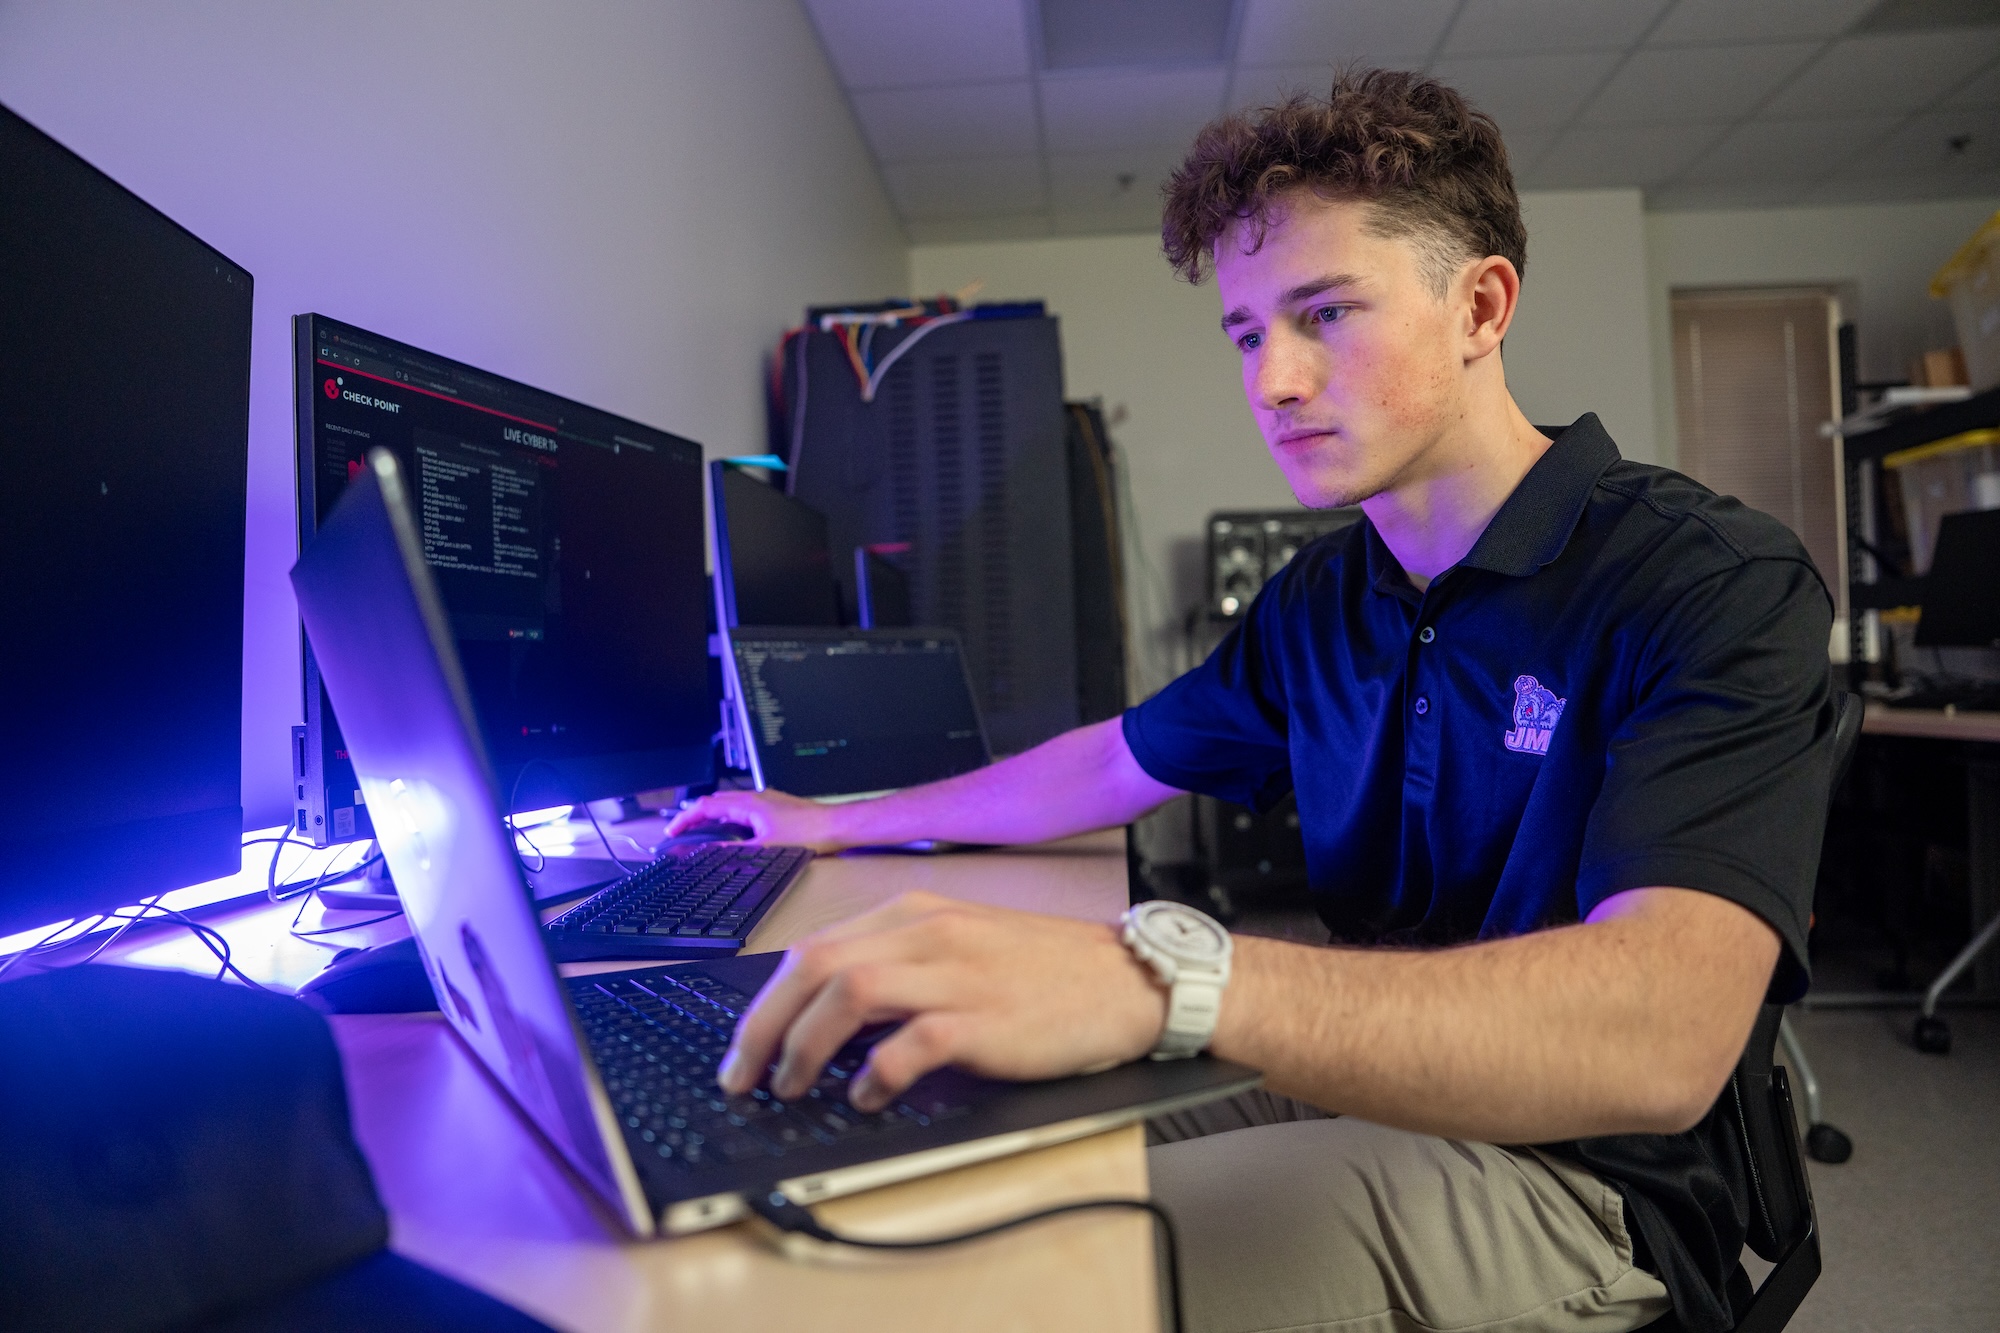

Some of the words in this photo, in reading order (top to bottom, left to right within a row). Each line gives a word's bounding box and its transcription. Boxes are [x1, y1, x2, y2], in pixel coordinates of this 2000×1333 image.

[343, 390, 372, 406] CHECK
[374, 398, 400, 414] POINT
[325, 423, 341, 432] RECENT
[341, 426, 353, 435] DAILY
[353, 429, 370, 438] ATTACKS
[504, 427, 521, 443] LIVE
[522, 432, 548, 449] CYBER
